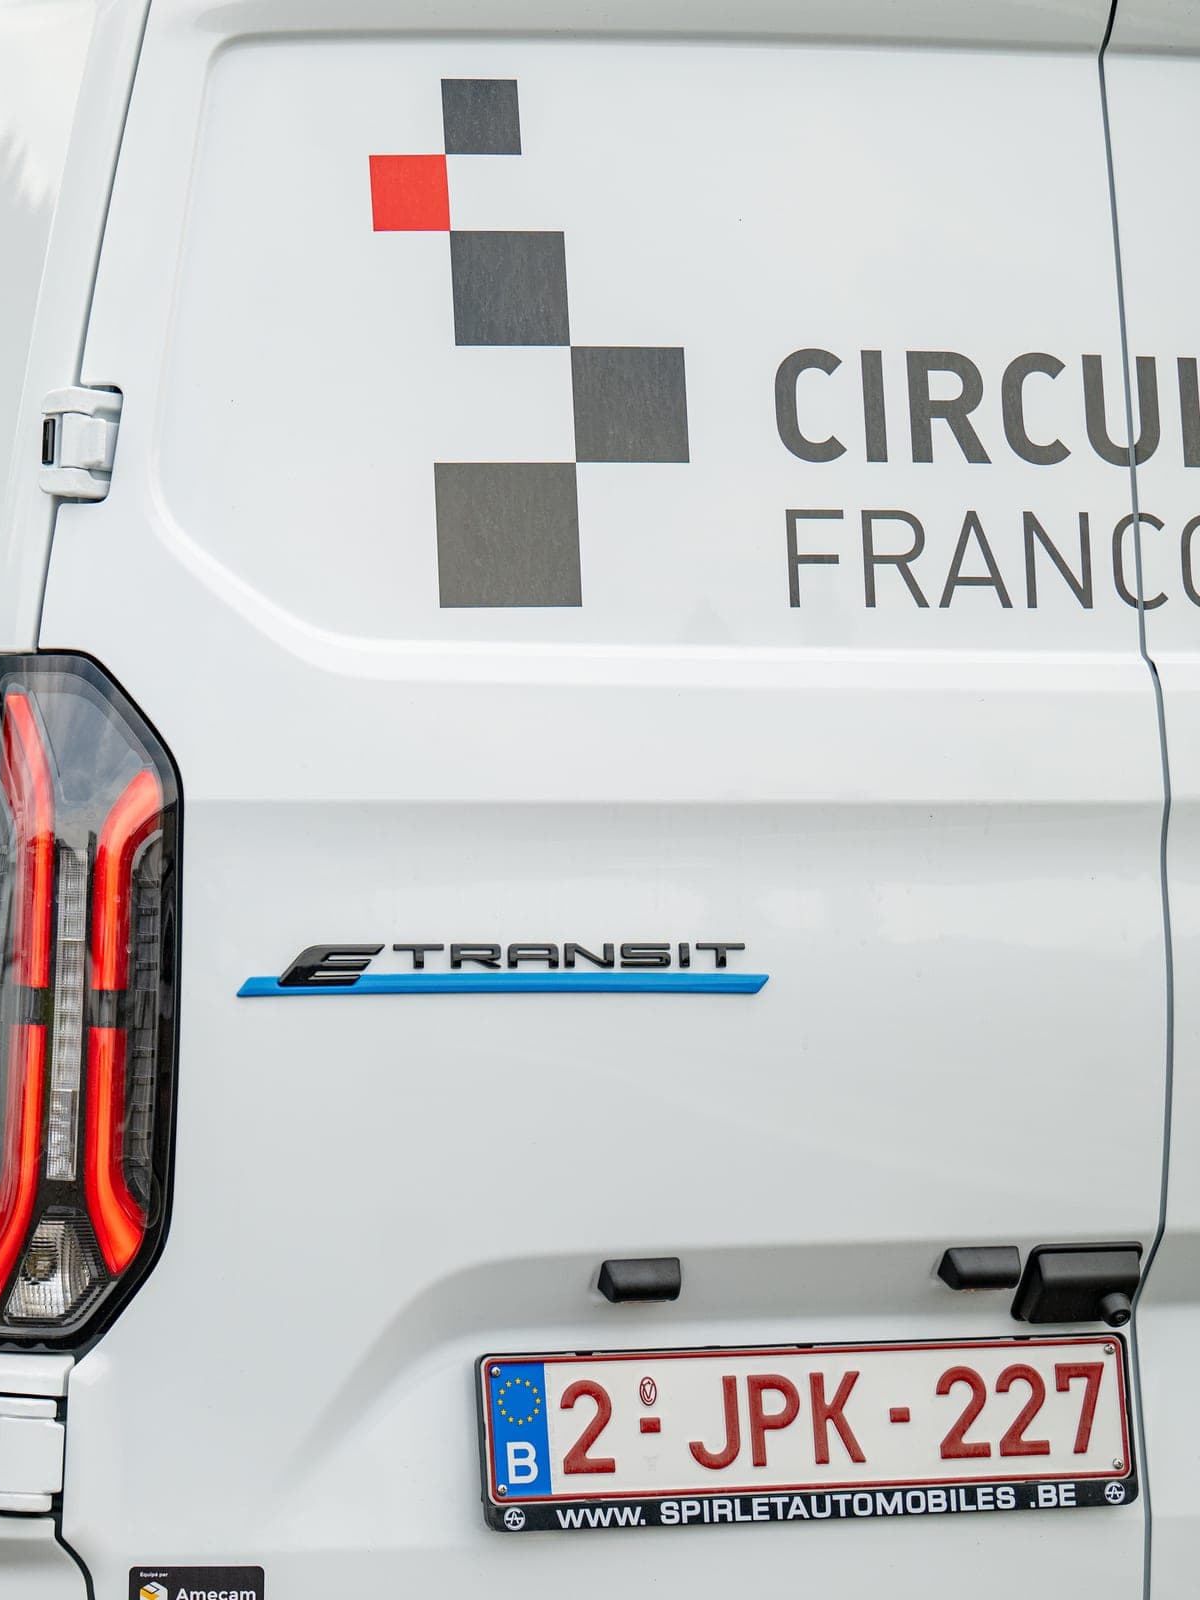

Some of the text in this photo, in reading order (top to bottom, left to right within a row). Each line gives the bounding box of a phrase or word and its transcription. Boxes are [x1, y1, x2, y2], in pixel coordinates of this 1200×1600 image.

[785, 509, 1200, 611] FRANC
[506, 1440, 539, 1485] B
[660, 1486, 1016, 1526] SPIRLETAUTOMOBILES
[176, 1588, 256, 1600] Amecam
